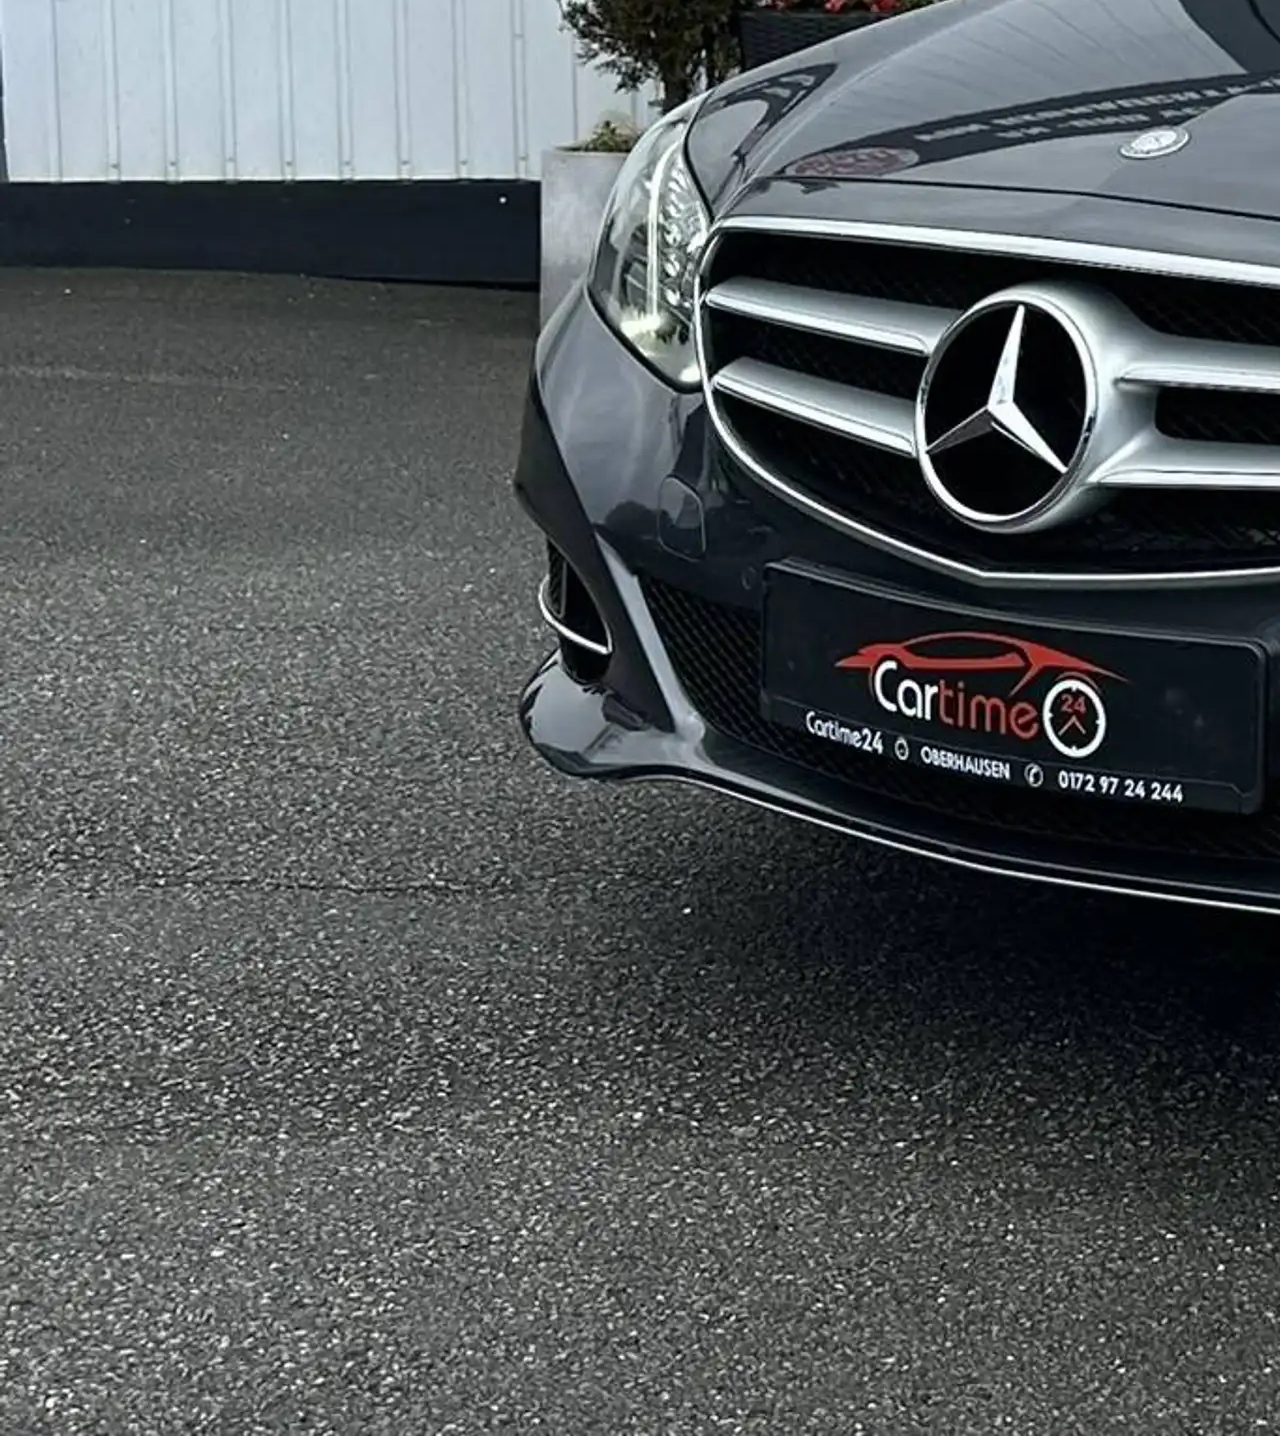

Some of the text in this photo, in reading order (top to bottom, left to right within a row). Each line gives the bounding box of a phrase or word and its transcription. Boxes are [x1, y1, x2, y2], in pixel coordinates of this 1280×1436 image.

[873, 660, 1086, 740] Cartime 24
[806, 710, 1183, 803] Cartime24 OBERHAUSEN 0172 97 24 244
